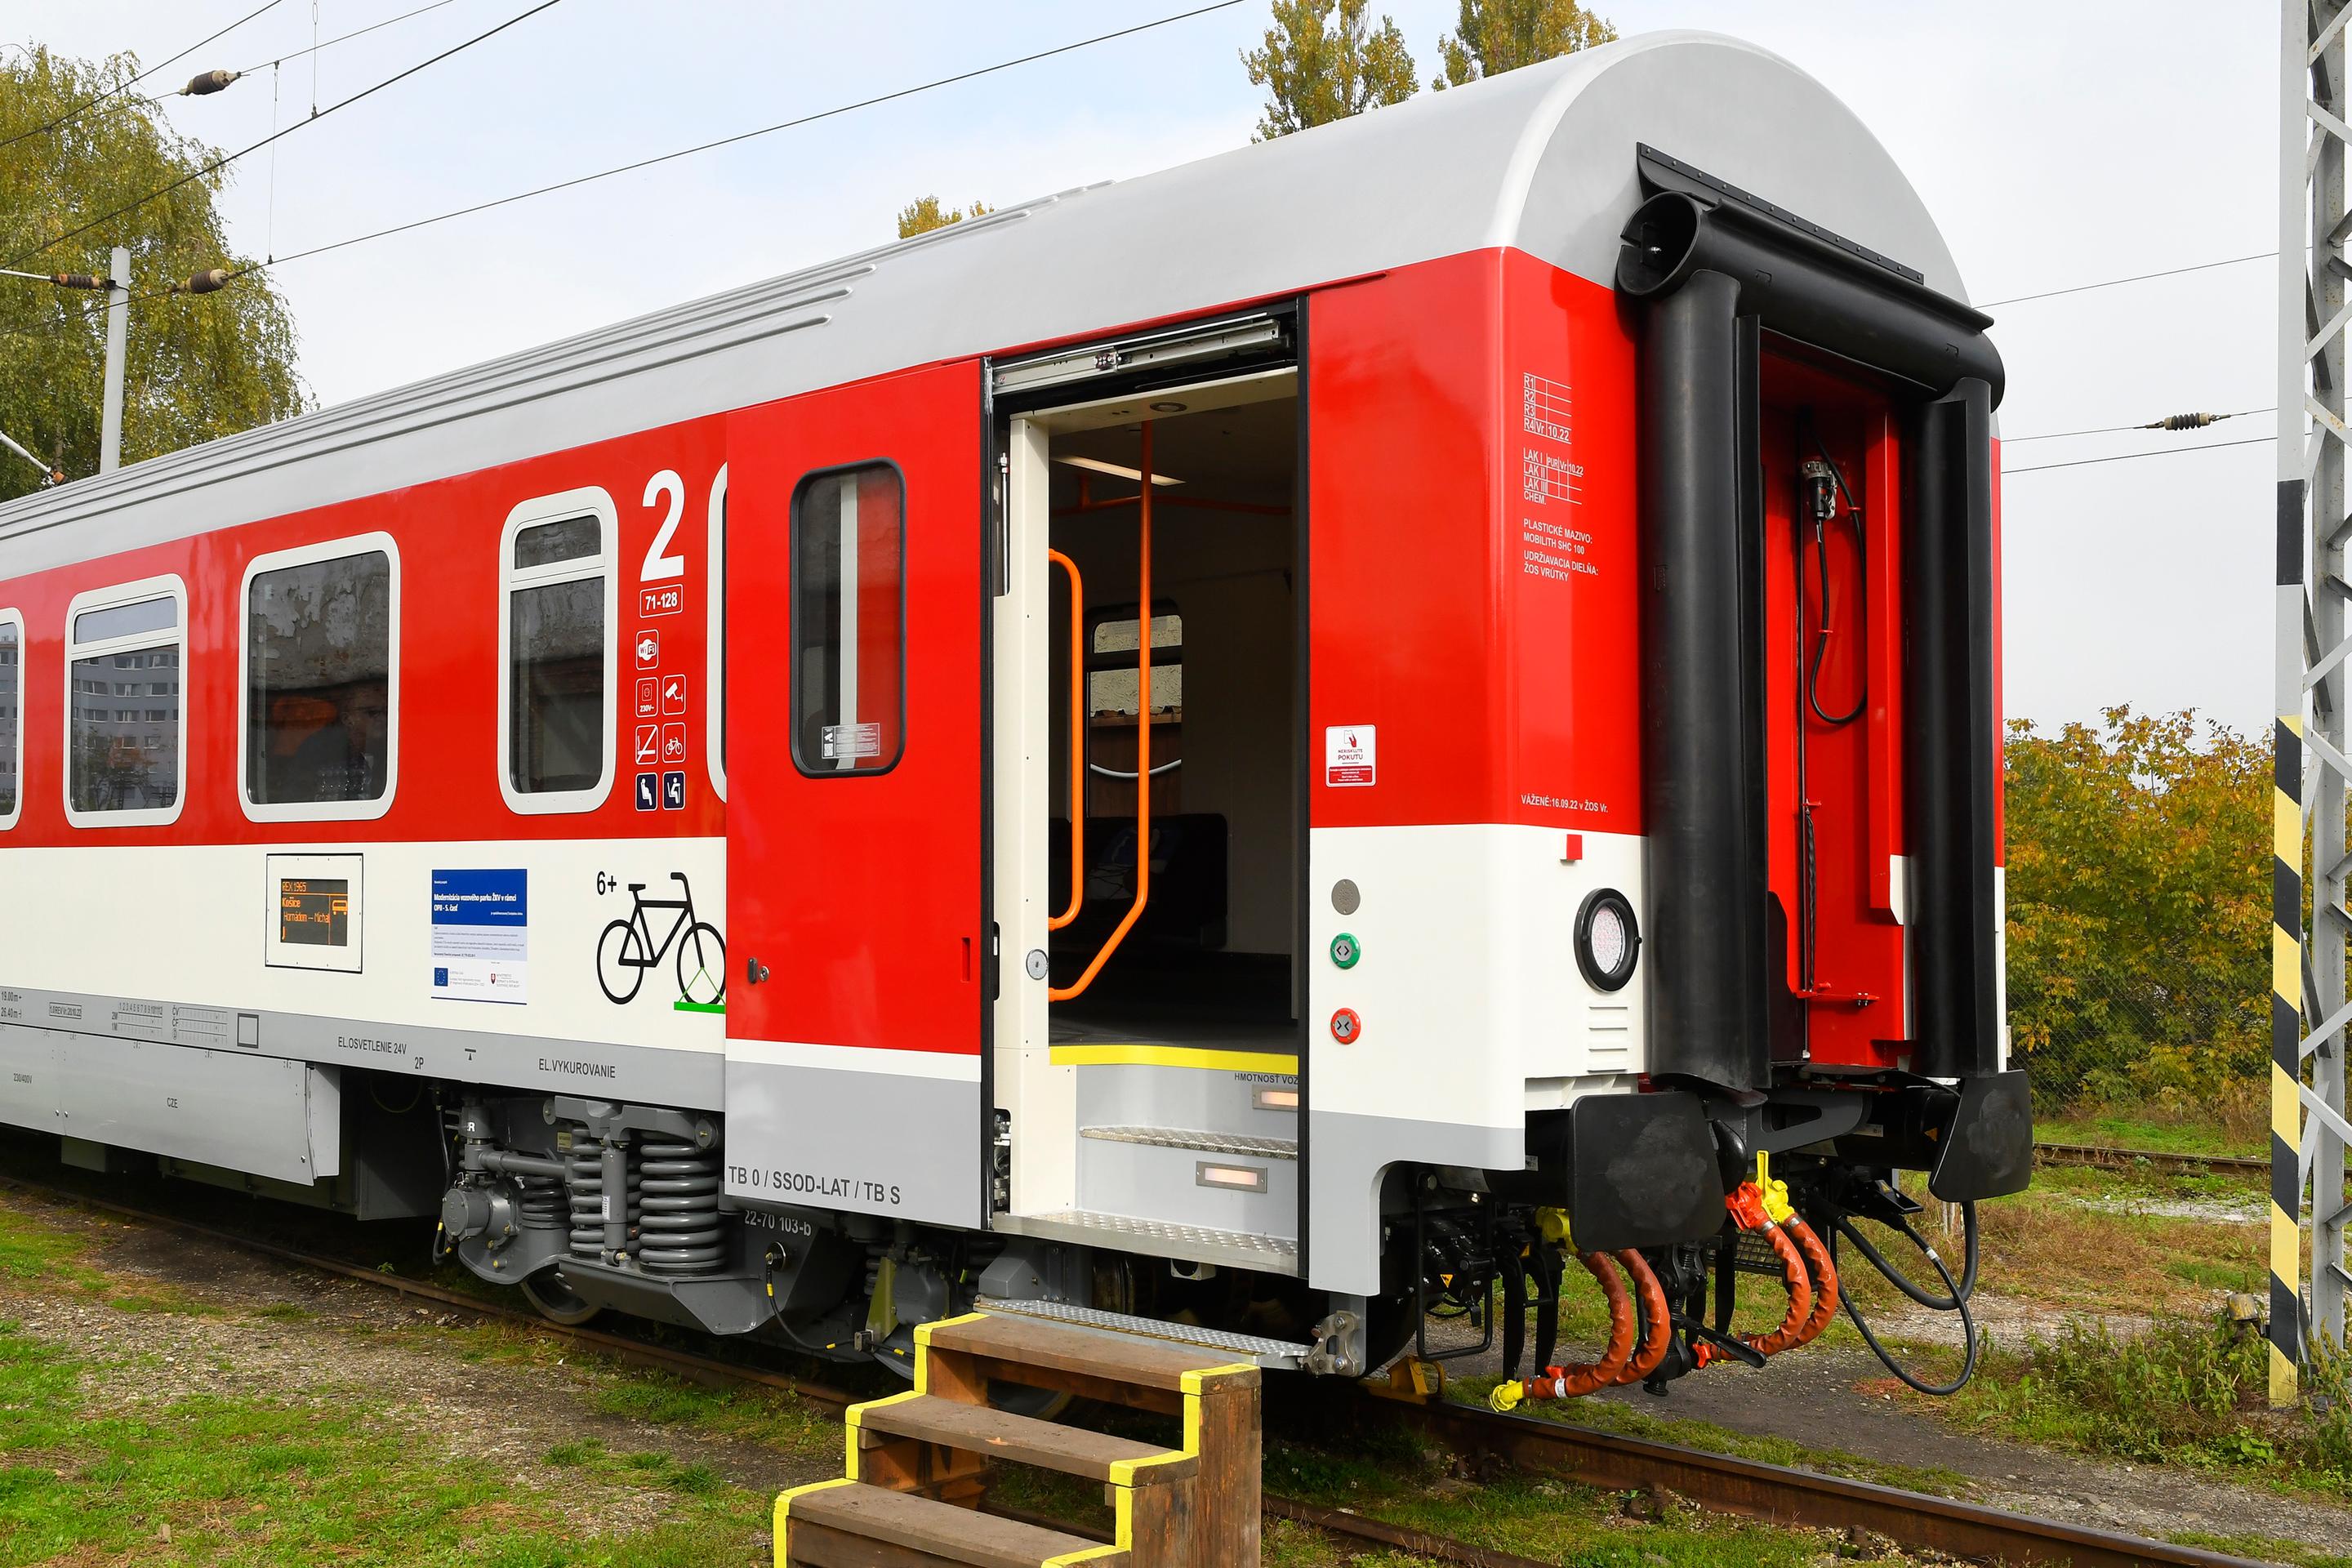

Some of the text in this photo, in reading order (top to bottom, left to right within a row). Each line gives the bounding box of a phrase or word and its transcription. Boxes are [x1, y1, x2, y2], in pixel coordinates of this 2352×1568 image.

[1524, 376, 1534, 389] R1
[1524, 390, 1535, 403] R2
[1524, 403, 1535, 416] R3
[1524, 417, 1569, 441] R4 Vr 10.22
[1524, 447, 1539, 462] LAK
[1548, 457, 1558, 468] PUR
[1560, 461, 1566, 470] Vr
[1569, 464, 1584, 475] 10.22
[1524, 462, 1539, 477] LAK
[1524, 476, 1539, 491] LAK
[1524, 491, 1546, 505] CHEM.
[640, 469, 685, 581] 2
[1523, 518, 1592, 544] PLASTICKÉ MAZIVO:
[1523, 532, 1584, 555] MOBILITH SHC 100
[1524, 550, 1598, 575] UDRŽIAVACIA DIELŇA:
[1524, 561, 1569, 581] ŽOS VRÚTKY
[645, 591, 678, 611] 71-128
[1584, 800, 1598, 812] ŽOS
[1600, 803, 1609, 813] Vr.
[597, 871, 617, 895] 6+
[479, 894, 492, 902] parku
[338, 1036, 407, 1054] EL.OSVETLENIE 24V
[415, 1057, 424, 1070] 2P
[539, 1058, 616, 1078] EL.VYKUROVANIE
[728, 1165, 747, 1185] TB
[764, 1169, 768, 1187] /
[773, 1171, 850, 1197] SSOD-LAT
[854, 1180, 859, 1199] /
[863, 1182, 884, 1202] TB
[890, 1186, 901, 1205] S
[744, 1209, 775, 1229] 22-70
